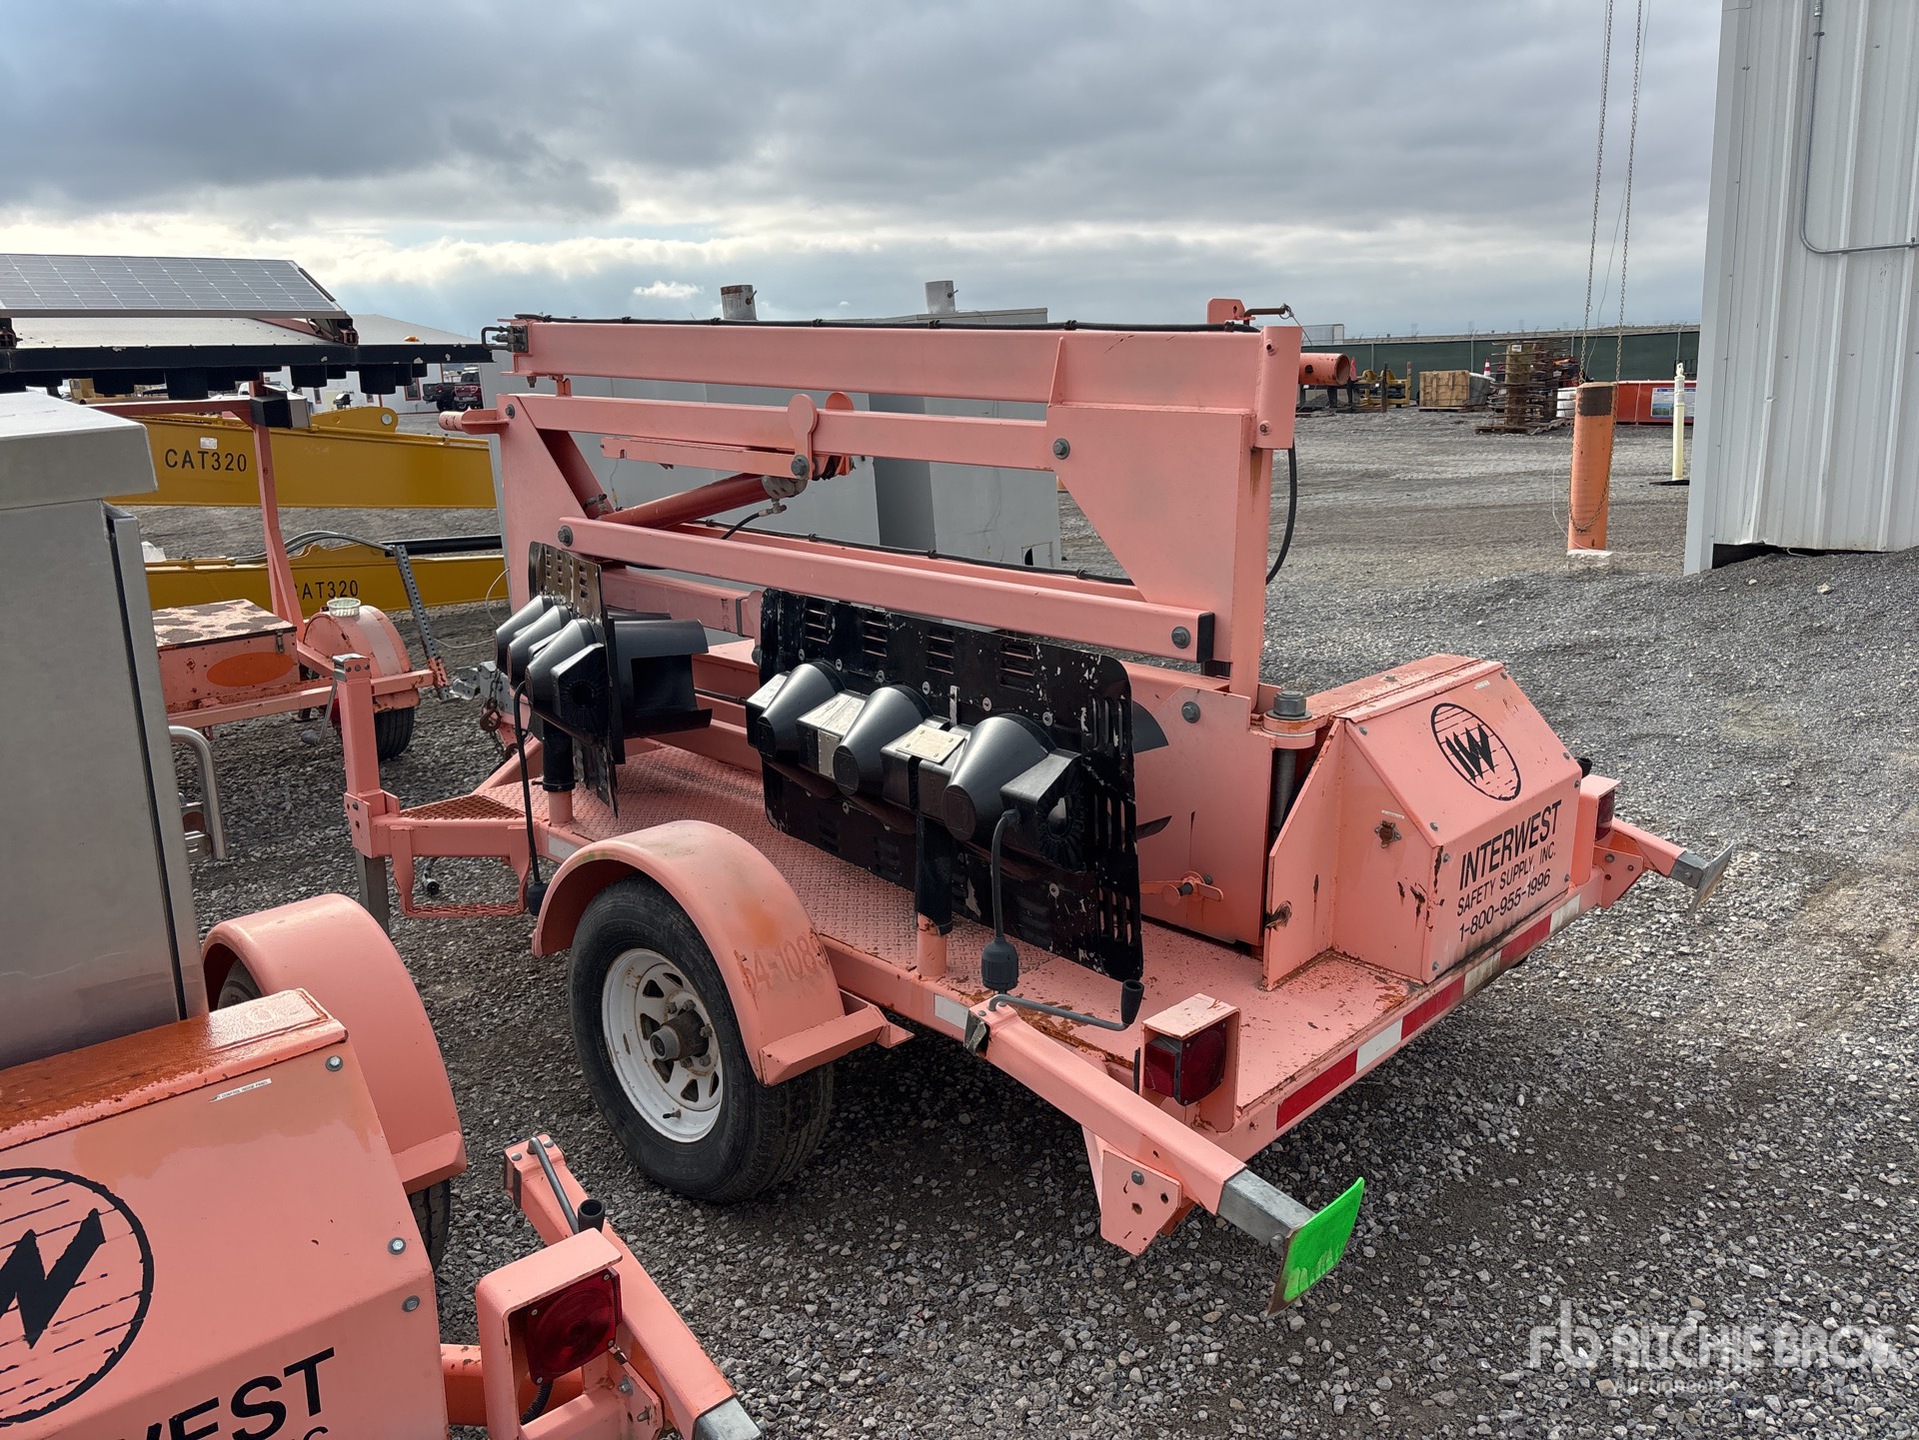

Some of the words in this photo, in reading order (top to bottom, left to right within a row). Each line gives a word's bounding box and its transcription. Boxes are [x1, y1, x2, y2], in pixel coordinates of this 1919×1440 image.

[165, 448, 247, 472] CAT320
[295, 579, 359, 600] AT320
[1456, 877, 1496, 917] SAFETY
[1499, 853, 1535, 890] SUPPLY,
[1539, 841, 1556, 866] INC.
[1459, 799, 1562, 891] INTERWEST
[1459, 868, 1552, 942] 1-800-955-1996
